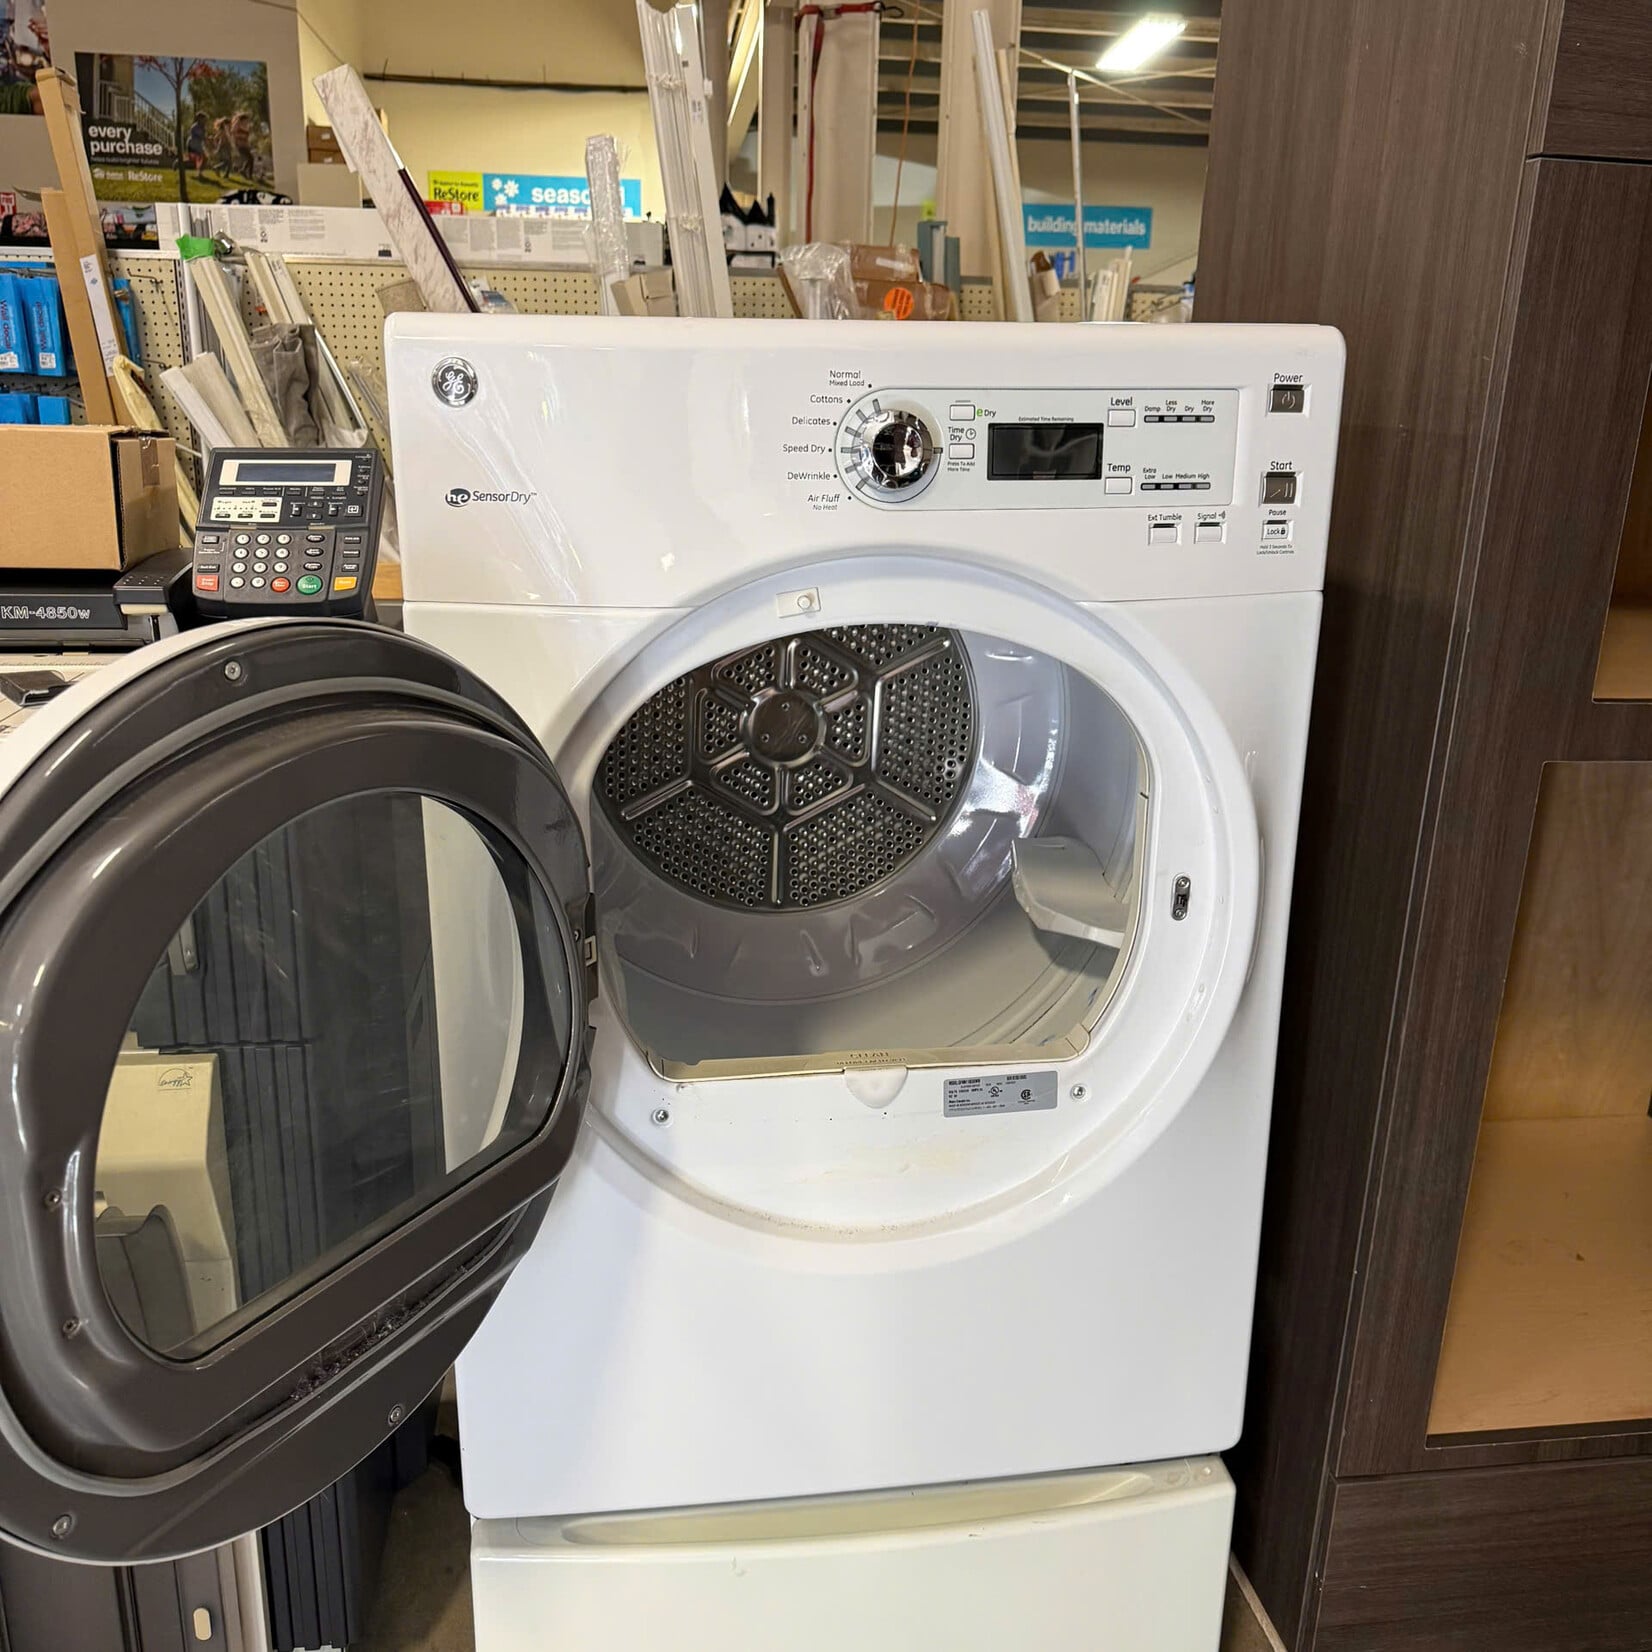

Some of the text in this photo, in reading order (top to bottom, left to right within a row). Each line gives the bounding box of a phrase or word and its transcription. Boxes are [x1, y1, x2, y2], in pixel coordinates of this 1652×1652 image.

[88, 125, 132, 141] every
[90, 140, 163, 155] purchase
[128, 170, 163, 182] ReStore
[433, 187, 479, 202] ReStore
[1083, 218, 1146, 236] materials
[829, 370, 861, 379] Normal
[1273, 373, 1303, 383] Power
[810, 394, 843, 404] Cottons
[1110, 397, 1133, 406] Level
[984, 409, 997, 418] Dry
[1184, 405, 1195, 413] Dry
[791, 416, 831, 425] Delicates
[949, 434, 962, 442] Dry
[782, 444, 826, 455] Speed Dry
[1107, 463, 1131, 474] Temp
[1270, 460, 1293, 470] Start
[787, 472, 831, 481] DeWrinkle
[807, 493, 841, 502] Air Fluff
[1159, 512, 1182, 521] Tumble
[1197, 511, 1217, 520] Signal
[1, 605, 91, 620] KM-4850w
